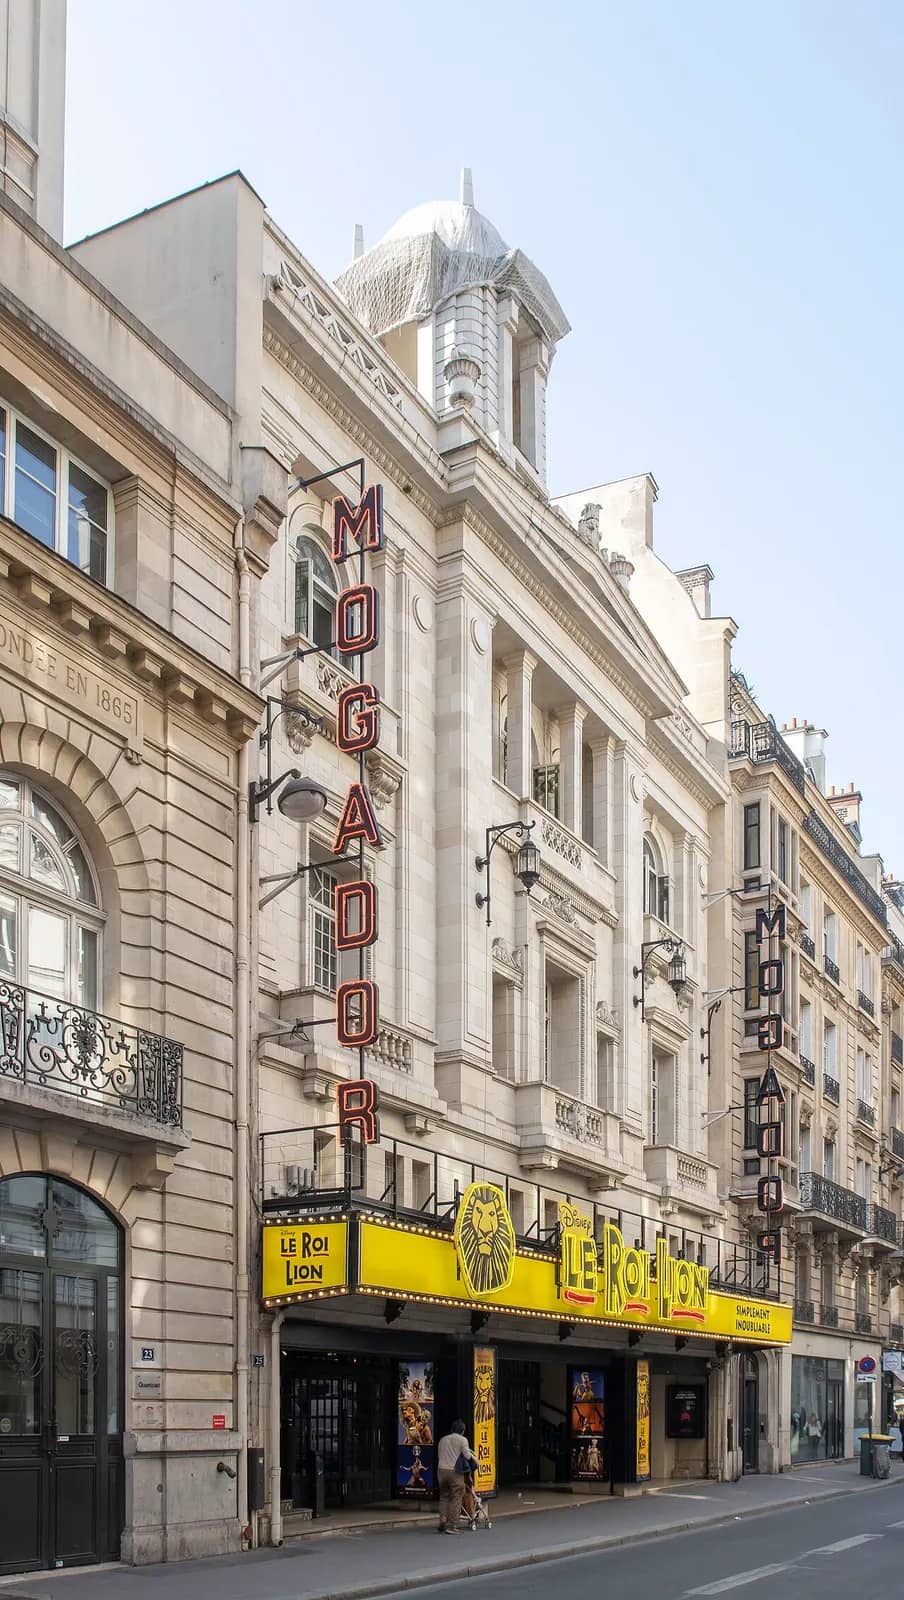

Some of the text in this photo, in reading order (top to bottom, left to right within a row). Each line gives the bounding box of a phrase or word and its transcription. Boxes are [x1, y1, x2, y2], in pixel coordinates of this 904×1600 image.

[66, 664, 88, 697] EN
[96, 684, 132, 724] 1865
[332, 482, 384, 1146] MOGADOR
[280, 1238, 297, 1253] LE
[562, 1234, 598, 1292] LE
[736, 1304, 770, 1320] SIMPLEMENT
[735, 1319, 771, 1334] INOUBLIABLE
[144, 1350, 153, 1360] 23
[481, 1431, 488, 1441] LE
